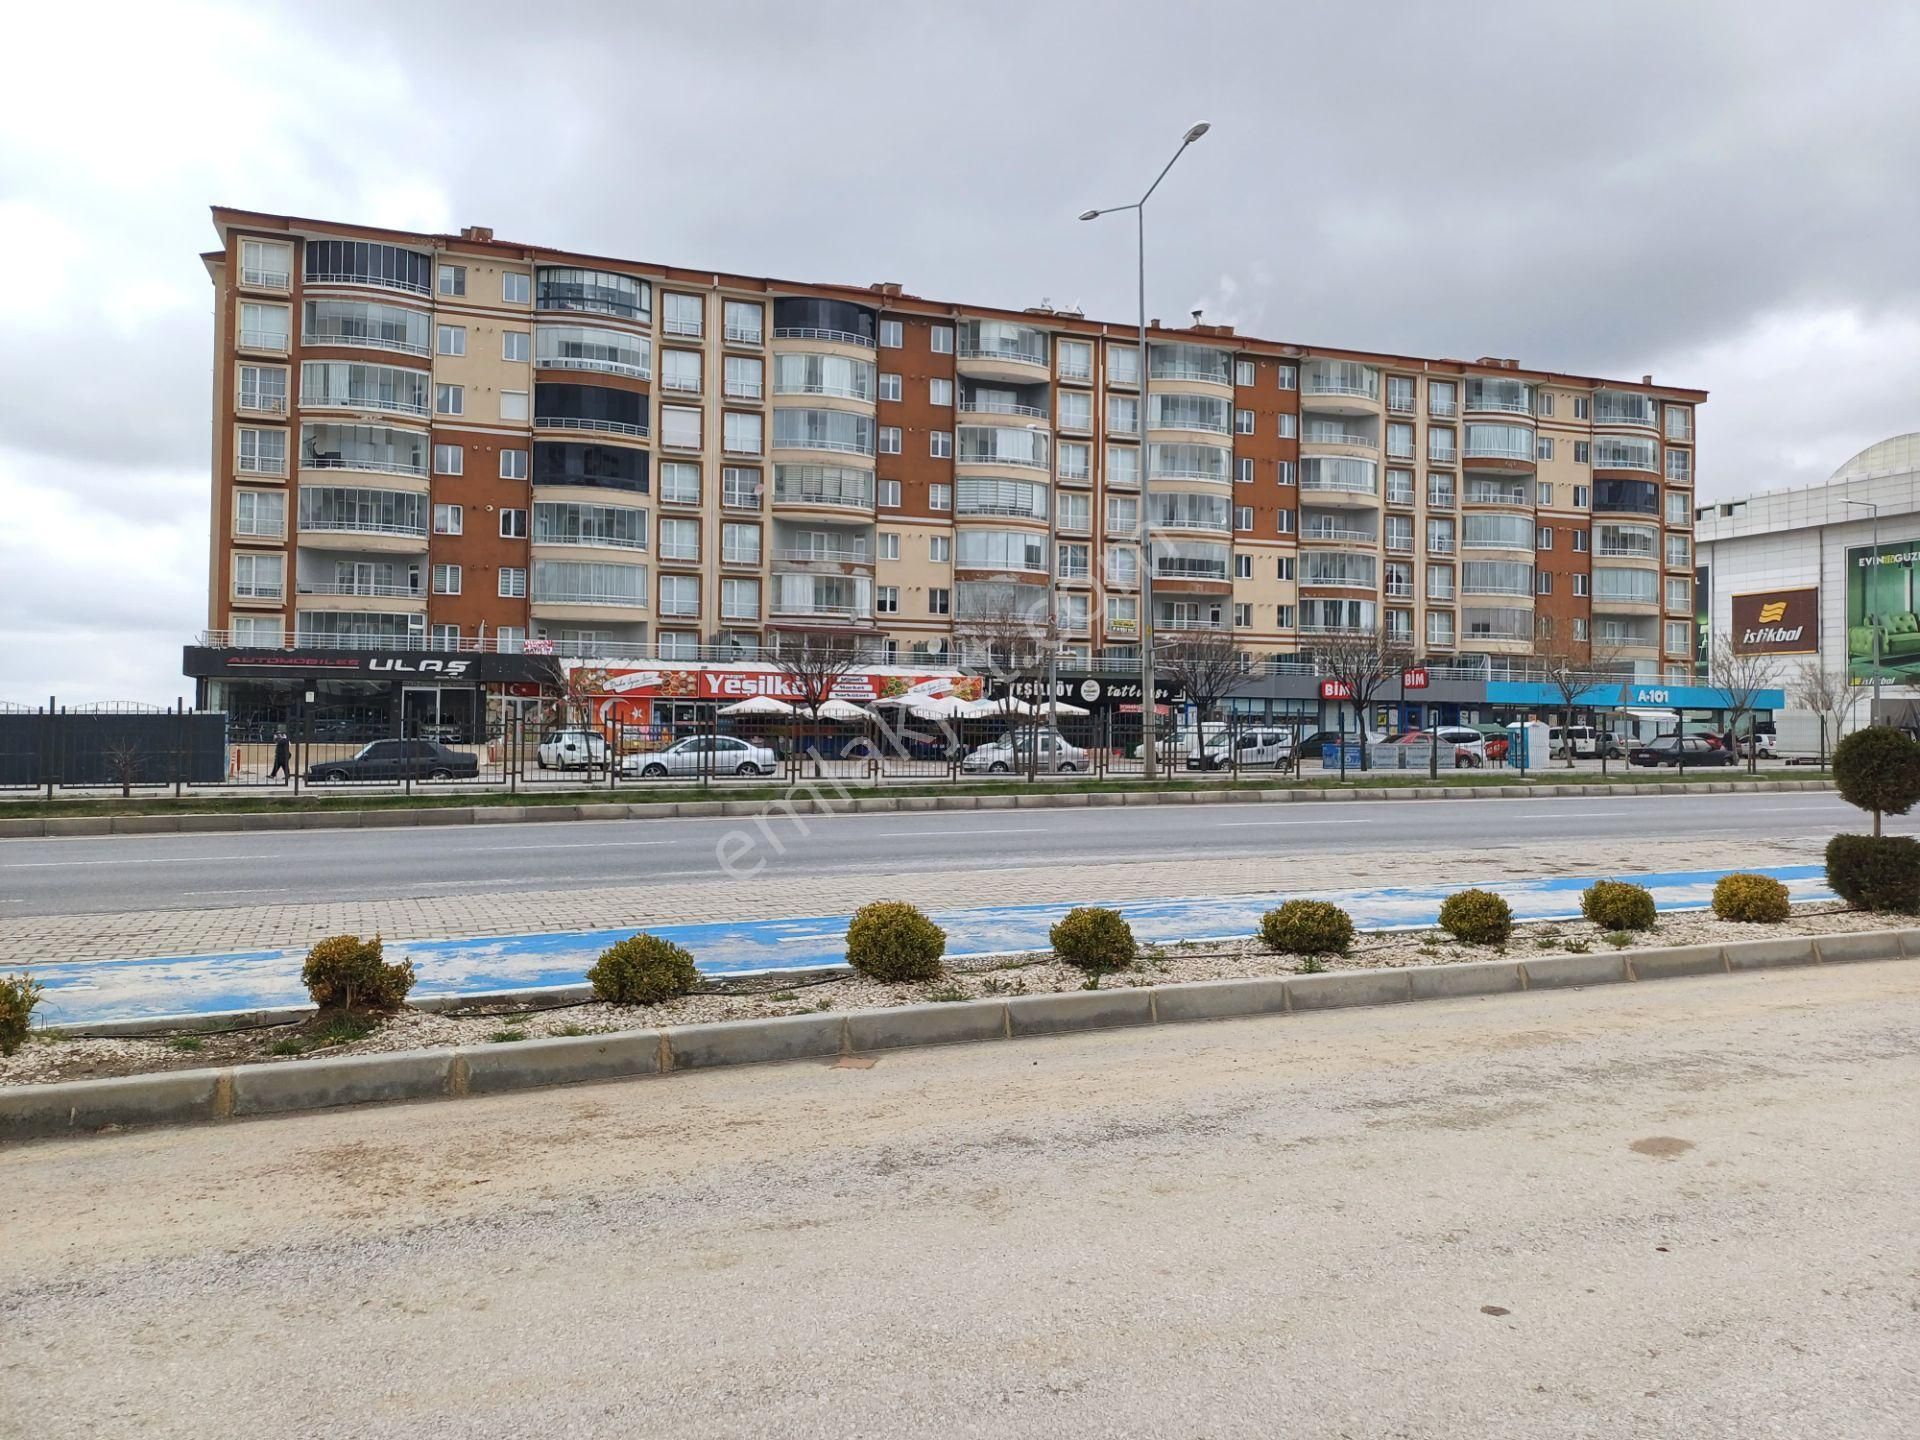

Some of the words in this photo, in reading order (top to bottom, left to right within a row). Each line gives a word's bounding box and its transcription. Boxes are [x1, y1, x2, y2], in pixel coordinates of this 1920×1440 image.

[1743, 625, 1804, 644] istikbal
[227, 656, 360, 666] AUTOMOBILES
[368, 658, 472, 676] ULAŞ
[1404, 670, 1425, 686] BİM
[1862, 677, 1895, 685] istibal
